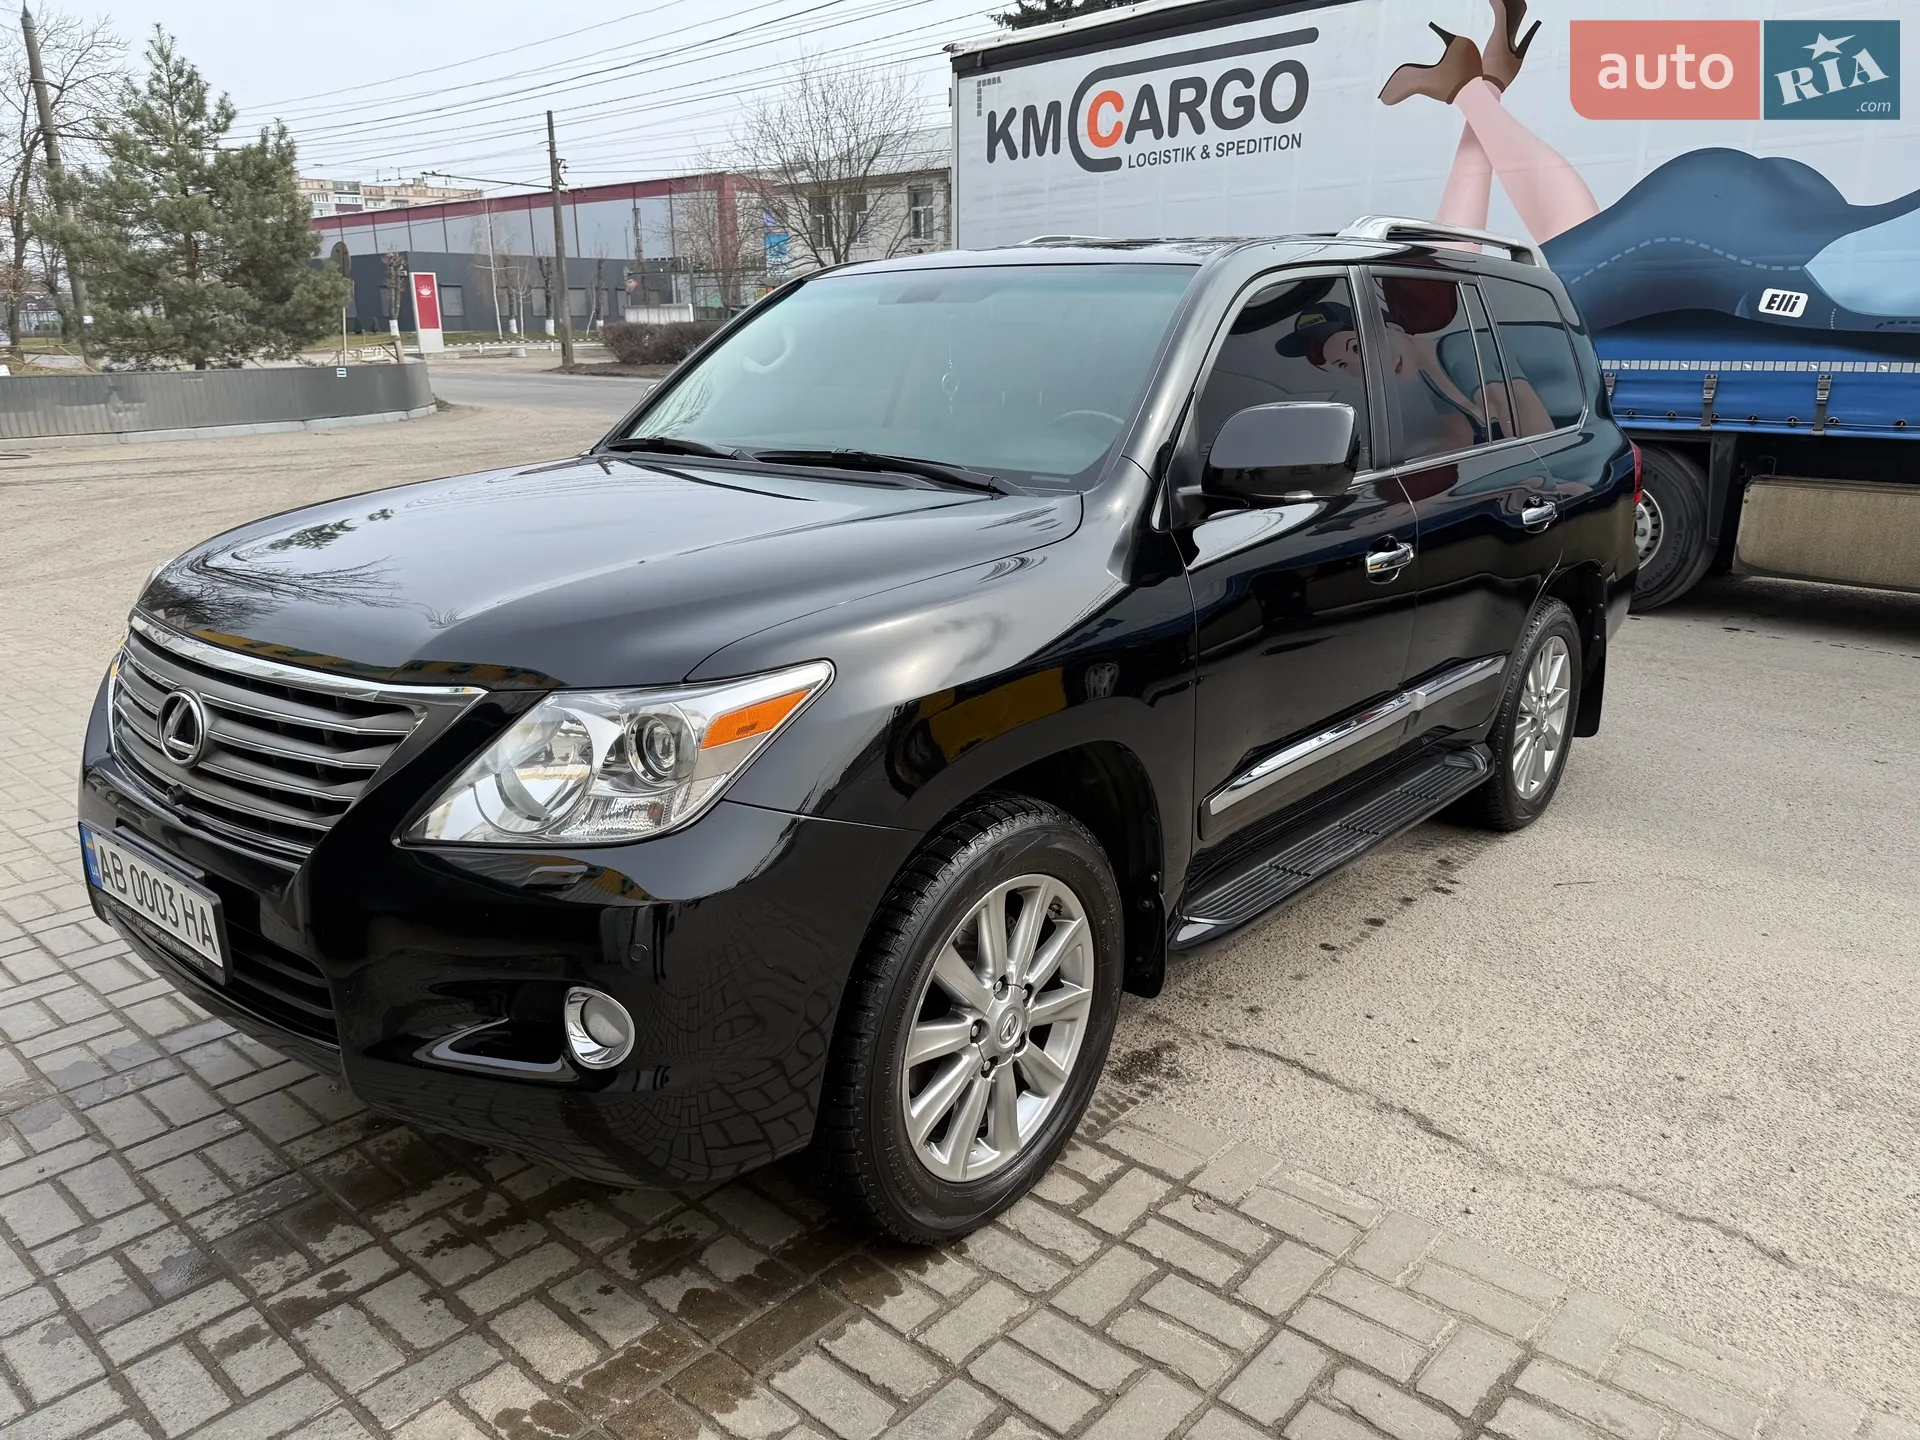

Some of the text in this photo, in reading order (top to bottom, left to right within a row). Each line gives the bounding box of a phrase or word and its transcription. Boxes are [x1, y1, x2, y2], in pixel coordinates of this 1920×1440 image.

[1128, 132, 1302, 169] LOGISTIK & SPEDITION
[1766, 293, 1800, 312] Elli
[90, 863, 100, 879] UA
[99, 844, 127, 895] AB
[129, 863, 179, 929] 0003
[180, 892, 218, 957] HA
